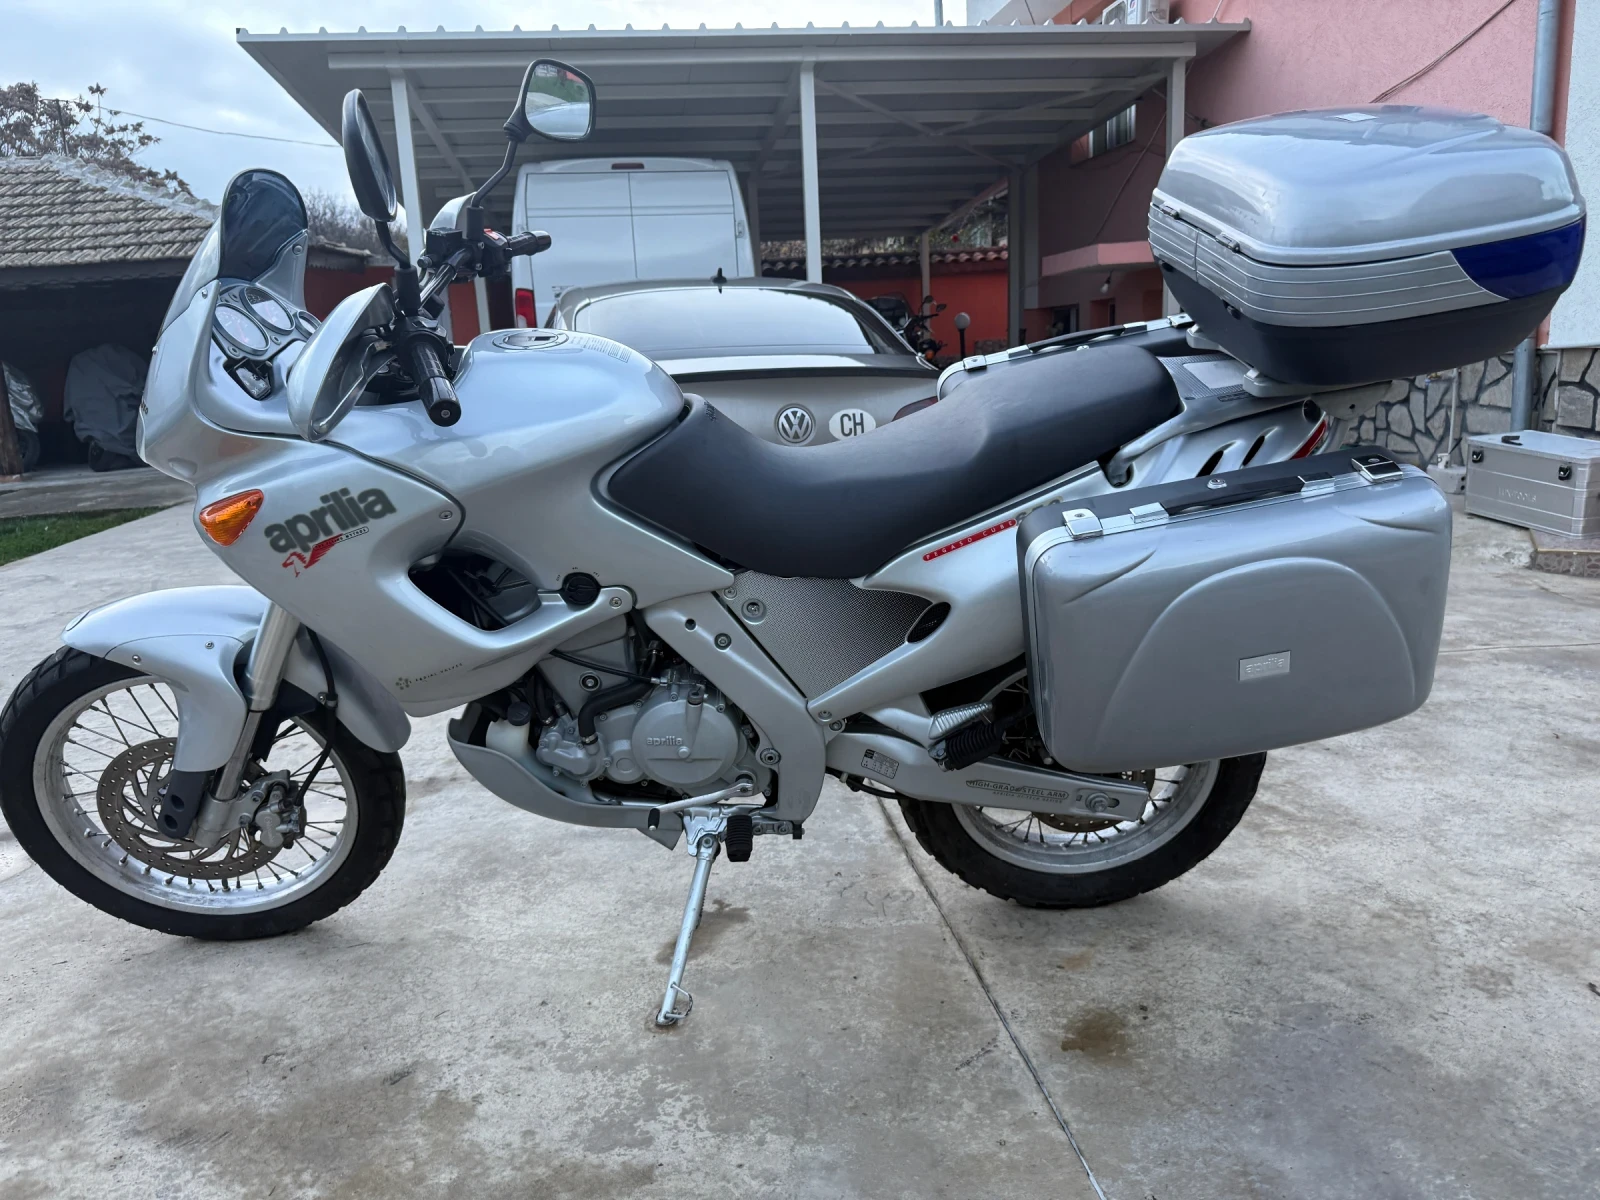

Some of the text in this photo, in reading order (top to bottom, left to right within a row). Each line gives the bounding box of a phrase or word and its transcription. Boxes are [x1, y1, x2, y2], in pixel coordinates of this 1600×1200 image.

[840, 413, 865, 437] CH
[264, 487, 397, 553] aprilia
[926, 520, 1014, 560] PEGASO CUBE
[1245, 656, 1285, 674] aprilia
[646, 735, 683, 747] aprilia
[968, 780, 1066, 799] HIGH-GRAD STEEL ARM
